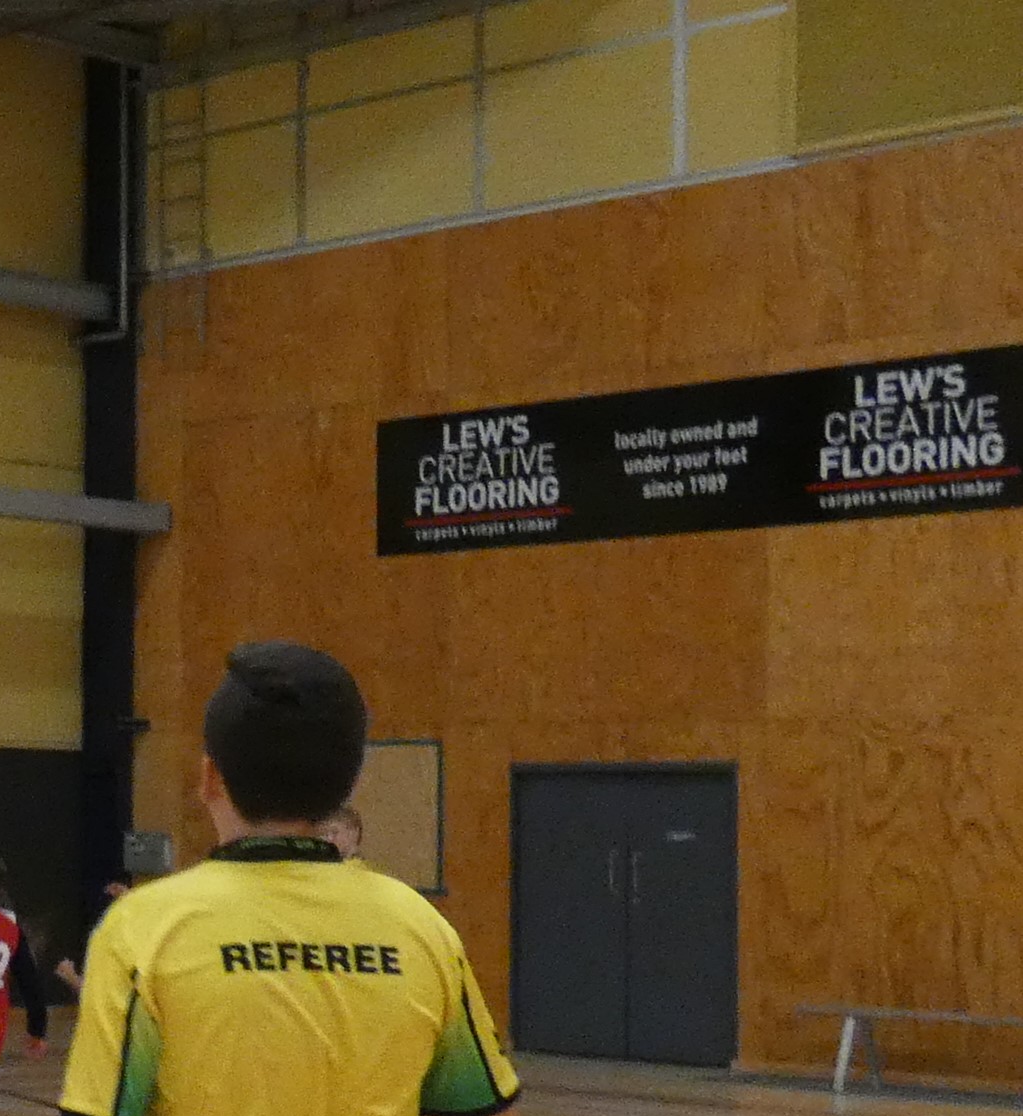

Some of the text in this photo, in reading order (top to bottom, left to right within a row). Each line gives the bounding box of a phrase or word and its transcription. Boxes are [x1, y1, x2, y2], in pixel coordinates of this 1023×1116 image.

[854, 363, 966, 408] LEW'S
[442, 414, 530, 451] LEW'S
[614, 414, 759, 450] locally owned and
[825, 394, 1000, 446] CREATIVE
[418, 442, 556, 485] CREATIVE
[623, 446, 748, 475] under your feet
[819, 431, 1005, 481] FLOORING
[414, 475, 560, 517] FLOORING
[642, 479, 685, 499] since
[220, 939, 403, 976] REFEREE
